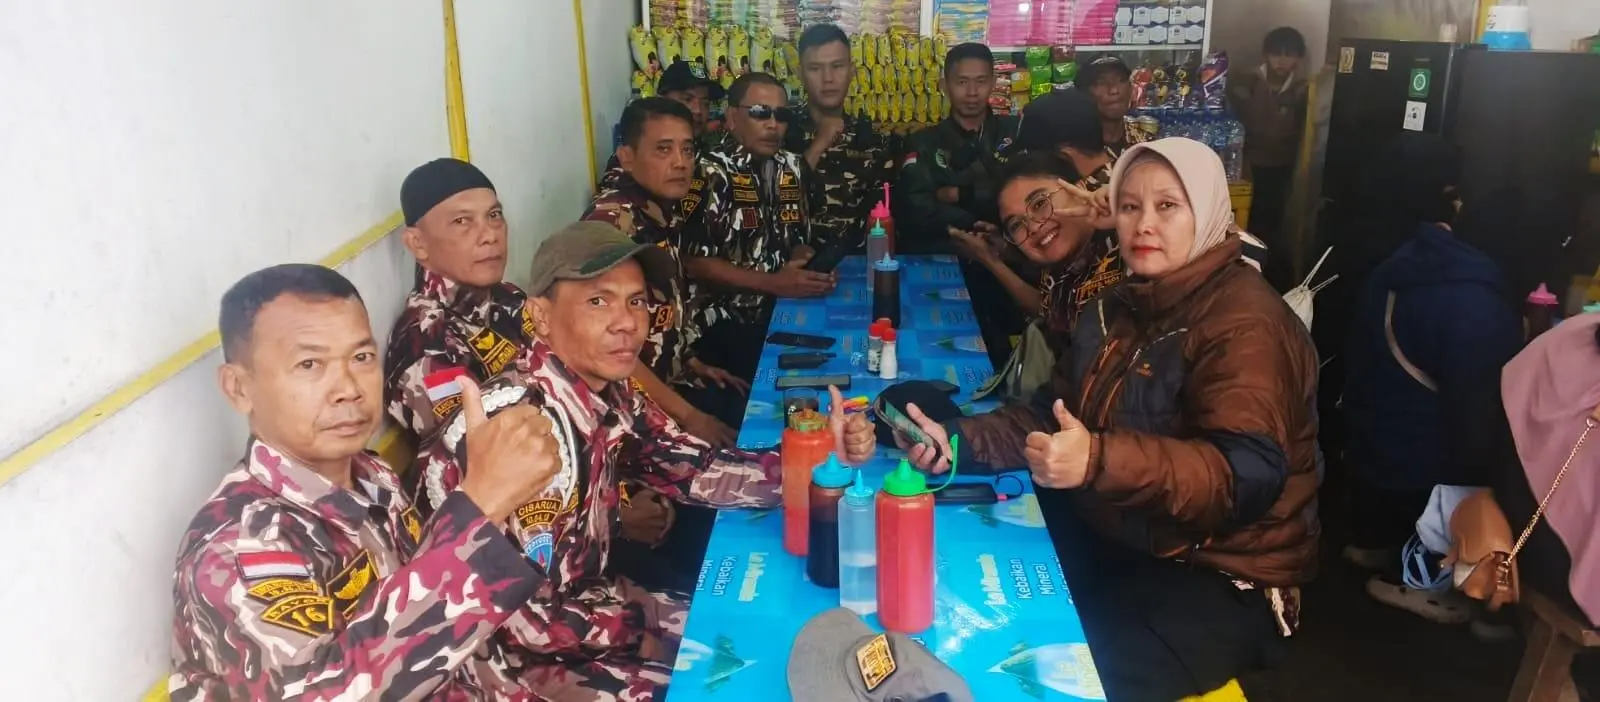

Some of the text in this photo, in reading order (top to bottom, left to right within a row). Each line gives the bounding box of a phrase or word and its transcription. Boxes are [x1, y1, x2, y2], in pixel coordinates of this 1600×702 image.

[518, 500, 557, 516] CISARUA
[712, 555, 737, 595] Kebaikan
[1010, 558, 1033, 599] Kebaikan
[1031, 563, 1056, 595] Mineral
[291, 606, 326, 627] 16
